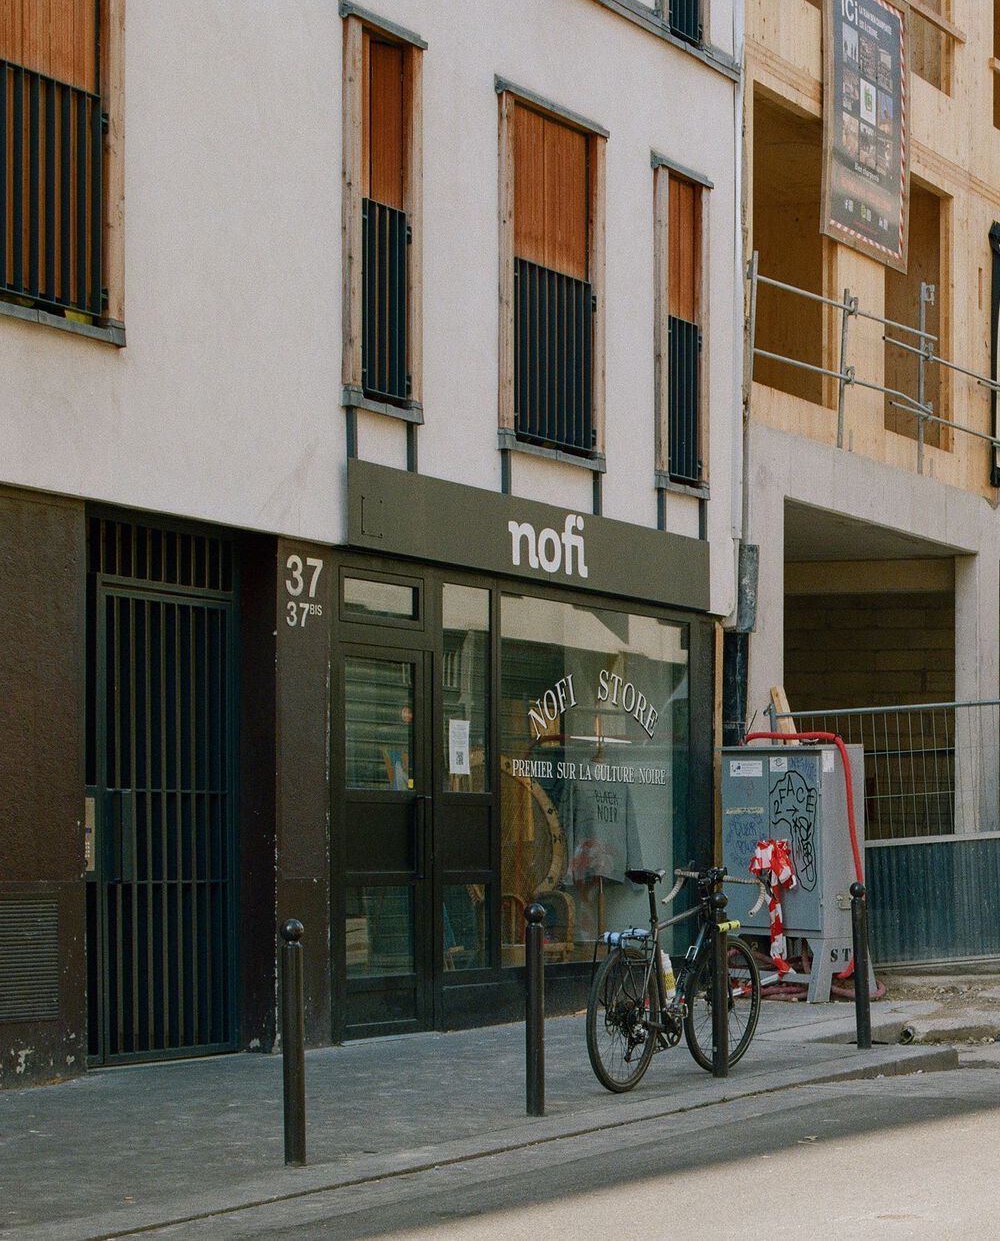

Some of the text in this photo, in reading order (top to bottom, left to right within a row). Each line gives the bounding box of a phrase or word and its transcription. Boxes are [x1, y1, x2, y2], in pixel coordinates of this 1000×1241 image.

[508, 514, 588, 578] nofi
[285, 554, 323, 598] 37
[528, 669, 659, 741] NOFI STORE
[512, 758, 666, 785] PREMIER SUR LA CULTURE NOIRE
